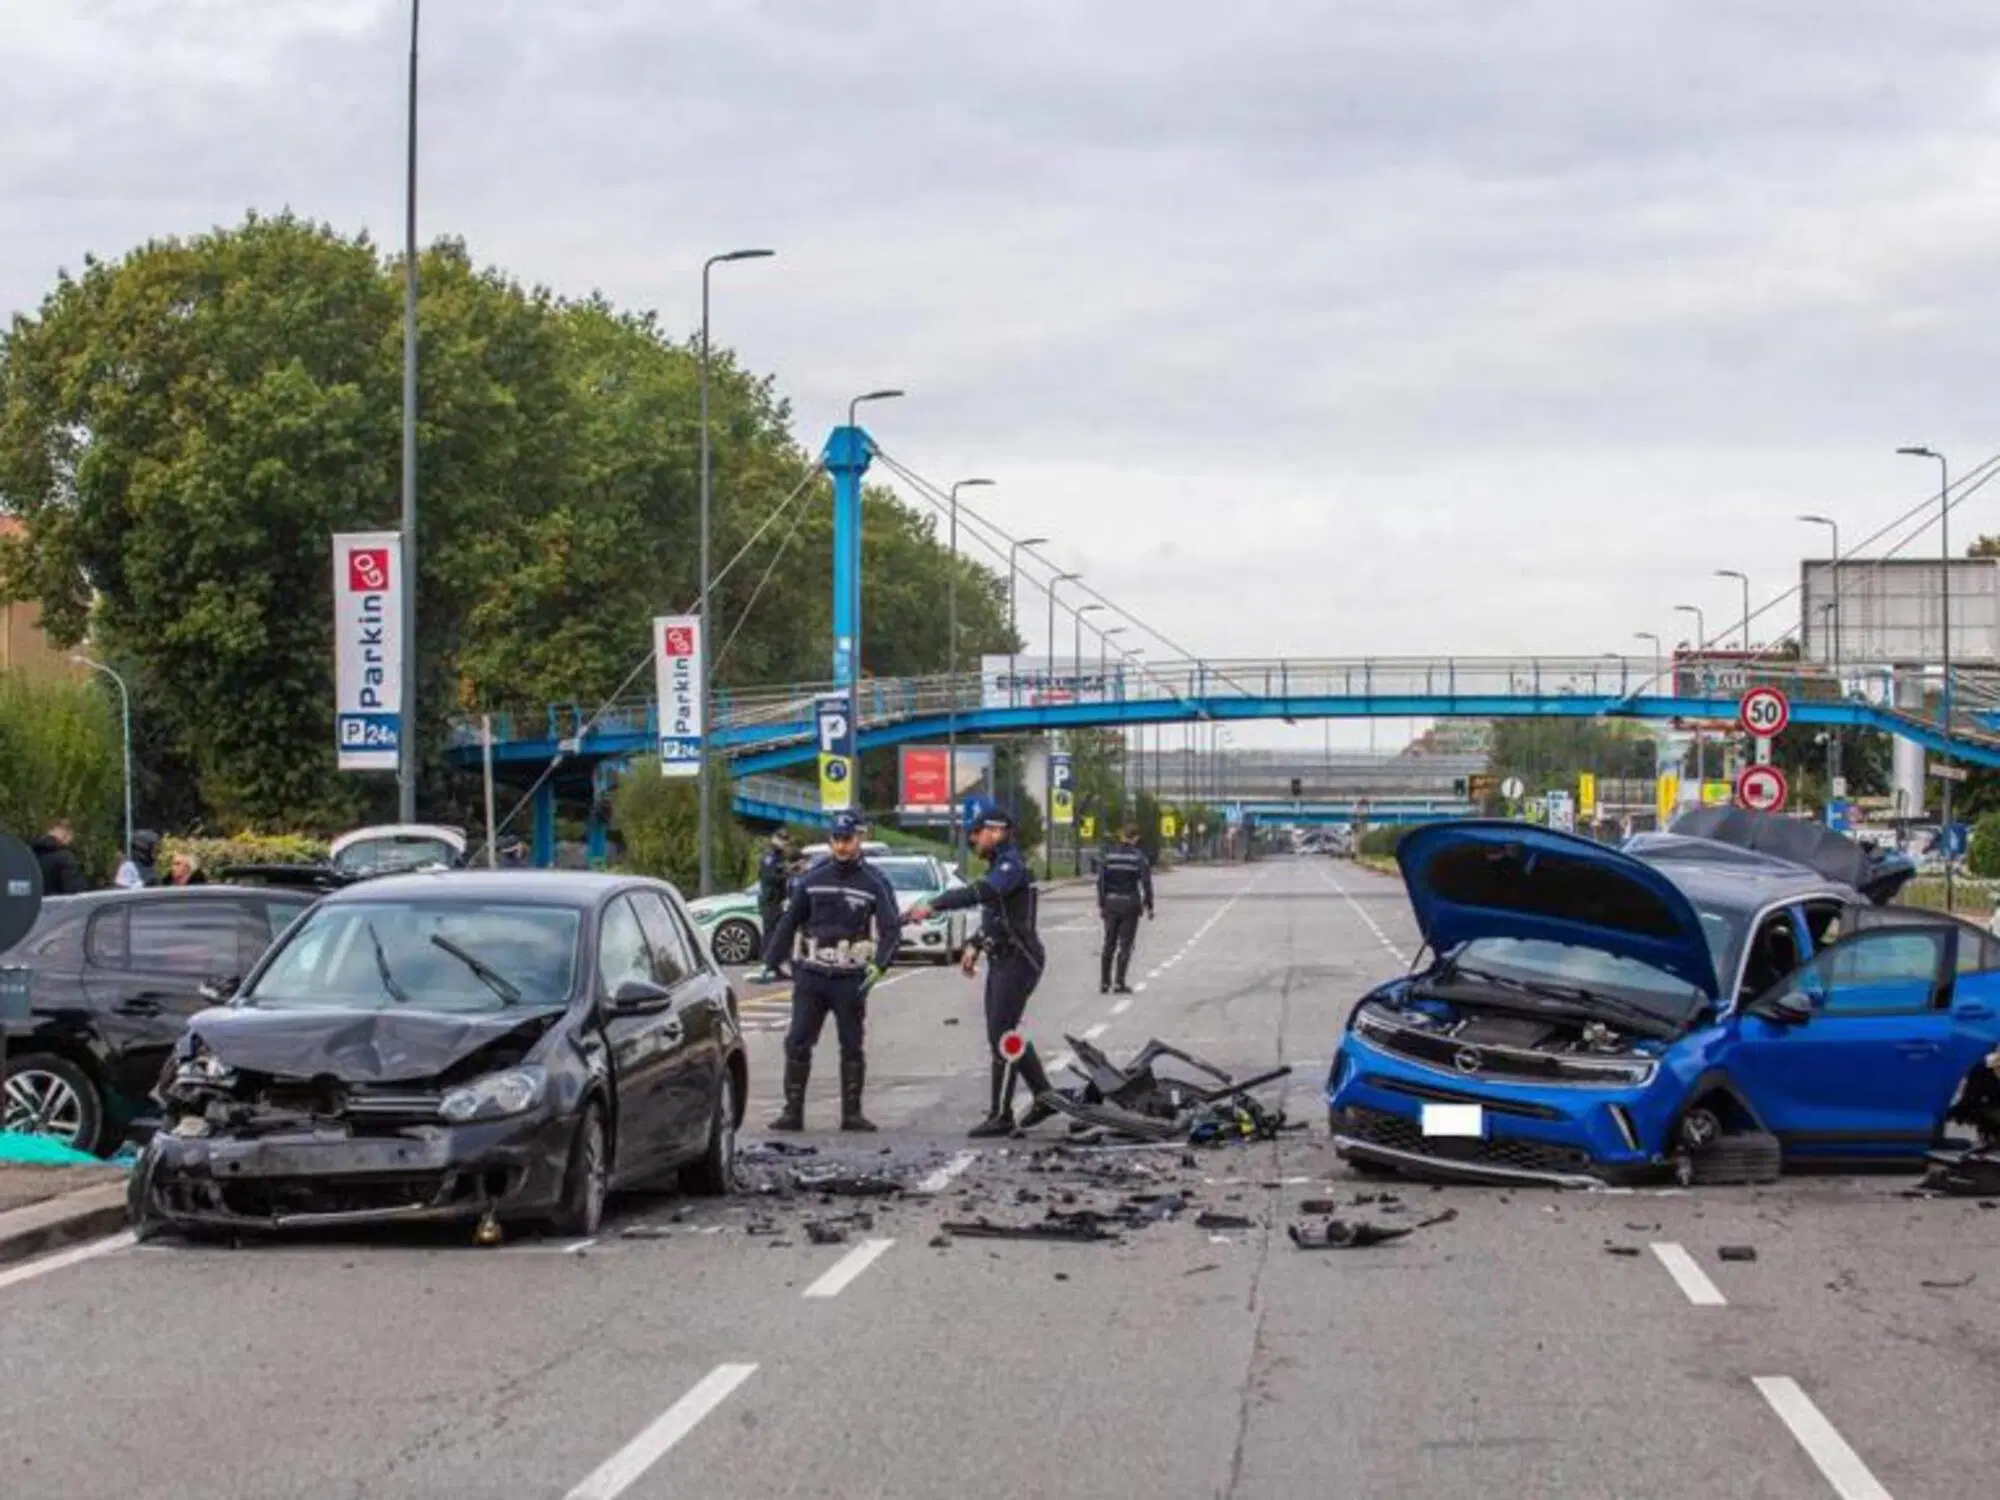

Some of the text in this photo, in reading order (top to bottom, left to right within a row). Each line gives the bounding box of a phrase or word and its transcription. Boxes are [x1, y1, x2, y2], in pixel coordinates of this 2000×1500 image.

[353, 553, 384, 708] Parkin GO
[673, 658, 691, 733] Parkin
[1751, 701, 1778, 723] 50
[820, 713, 848, 752] P
